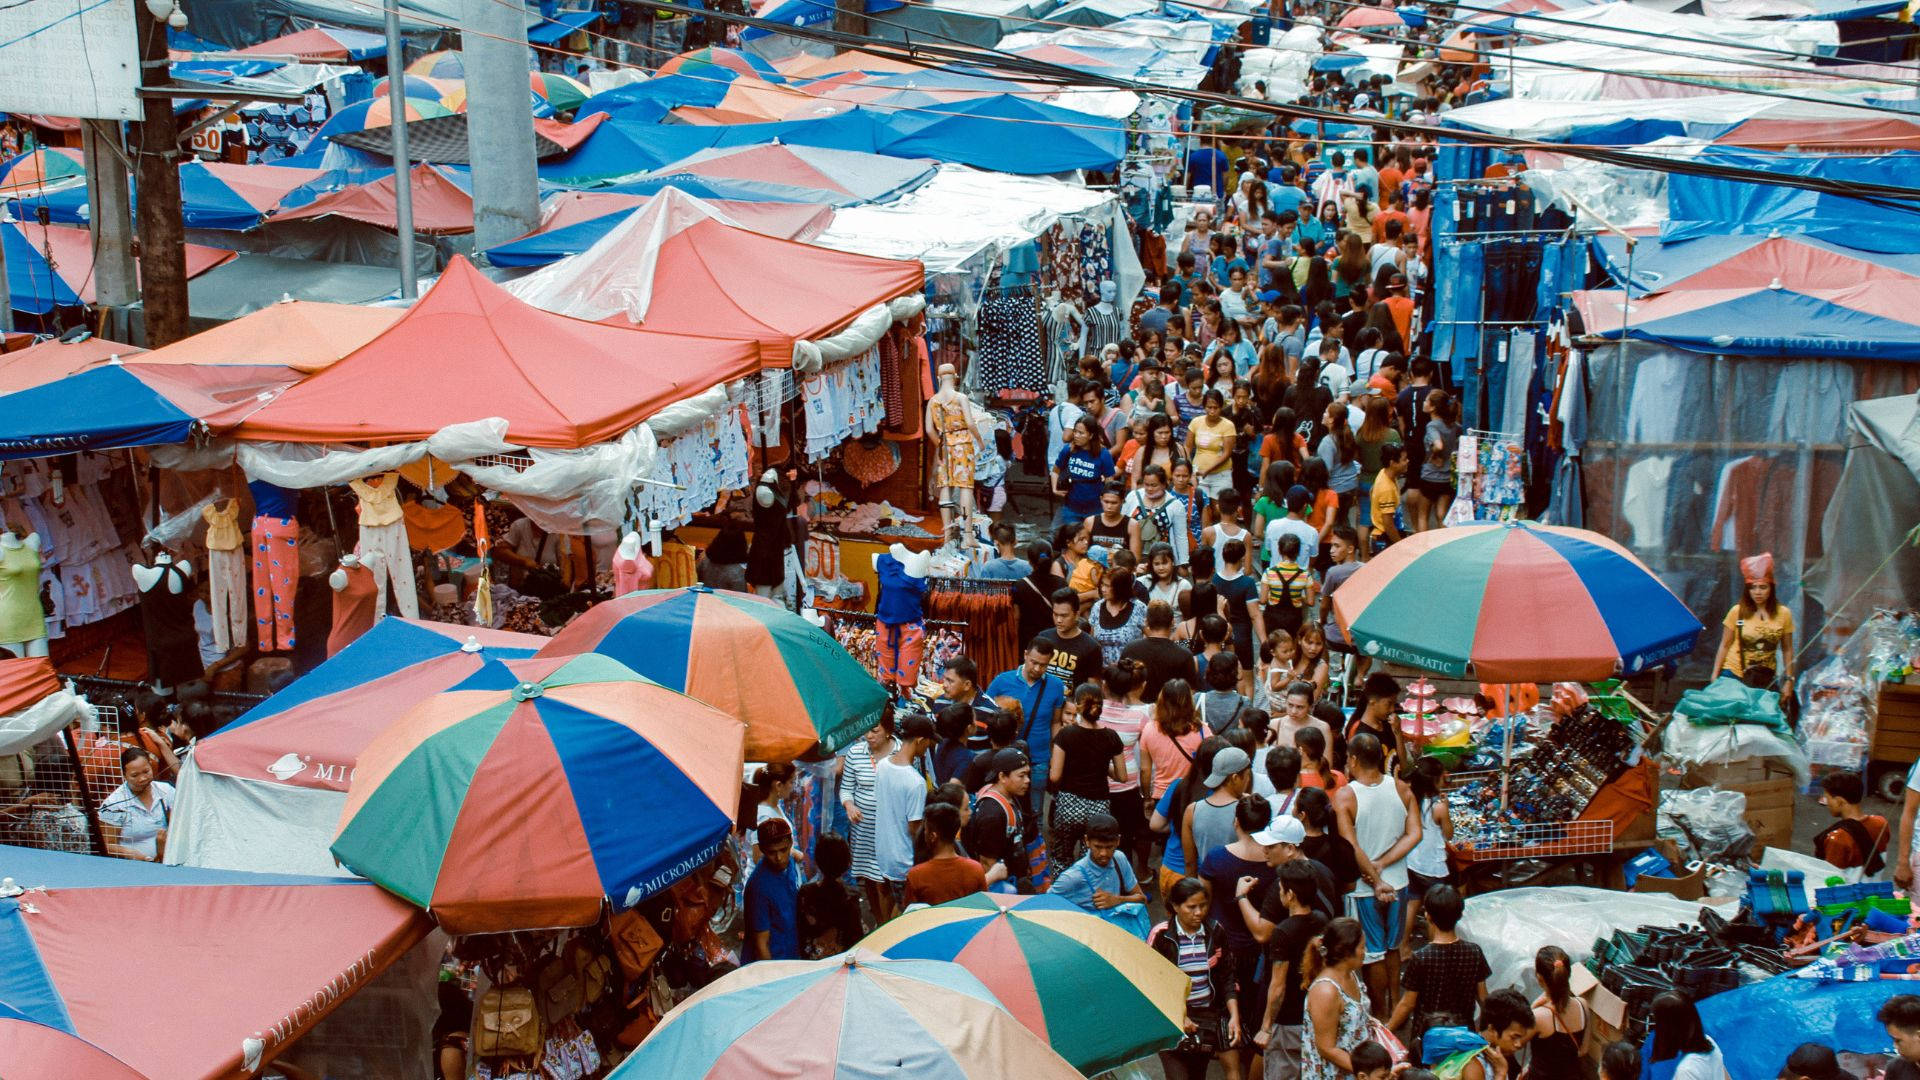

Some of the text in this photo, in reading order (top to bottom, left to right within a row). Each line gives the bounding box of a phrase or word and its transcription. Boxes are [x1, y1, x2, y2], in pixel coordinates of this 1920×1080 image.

[194, 129, 220, 150] 50
[1743, 336, 1878, 351] MICROMATIC
[1048, 648, 1078, 671] 205
[1382, 646, 1452, 673] MICROMATIC
[644, 840, 723, 895] MICROMATIC
[269, 948, 376, 1048] MICROMATIC
